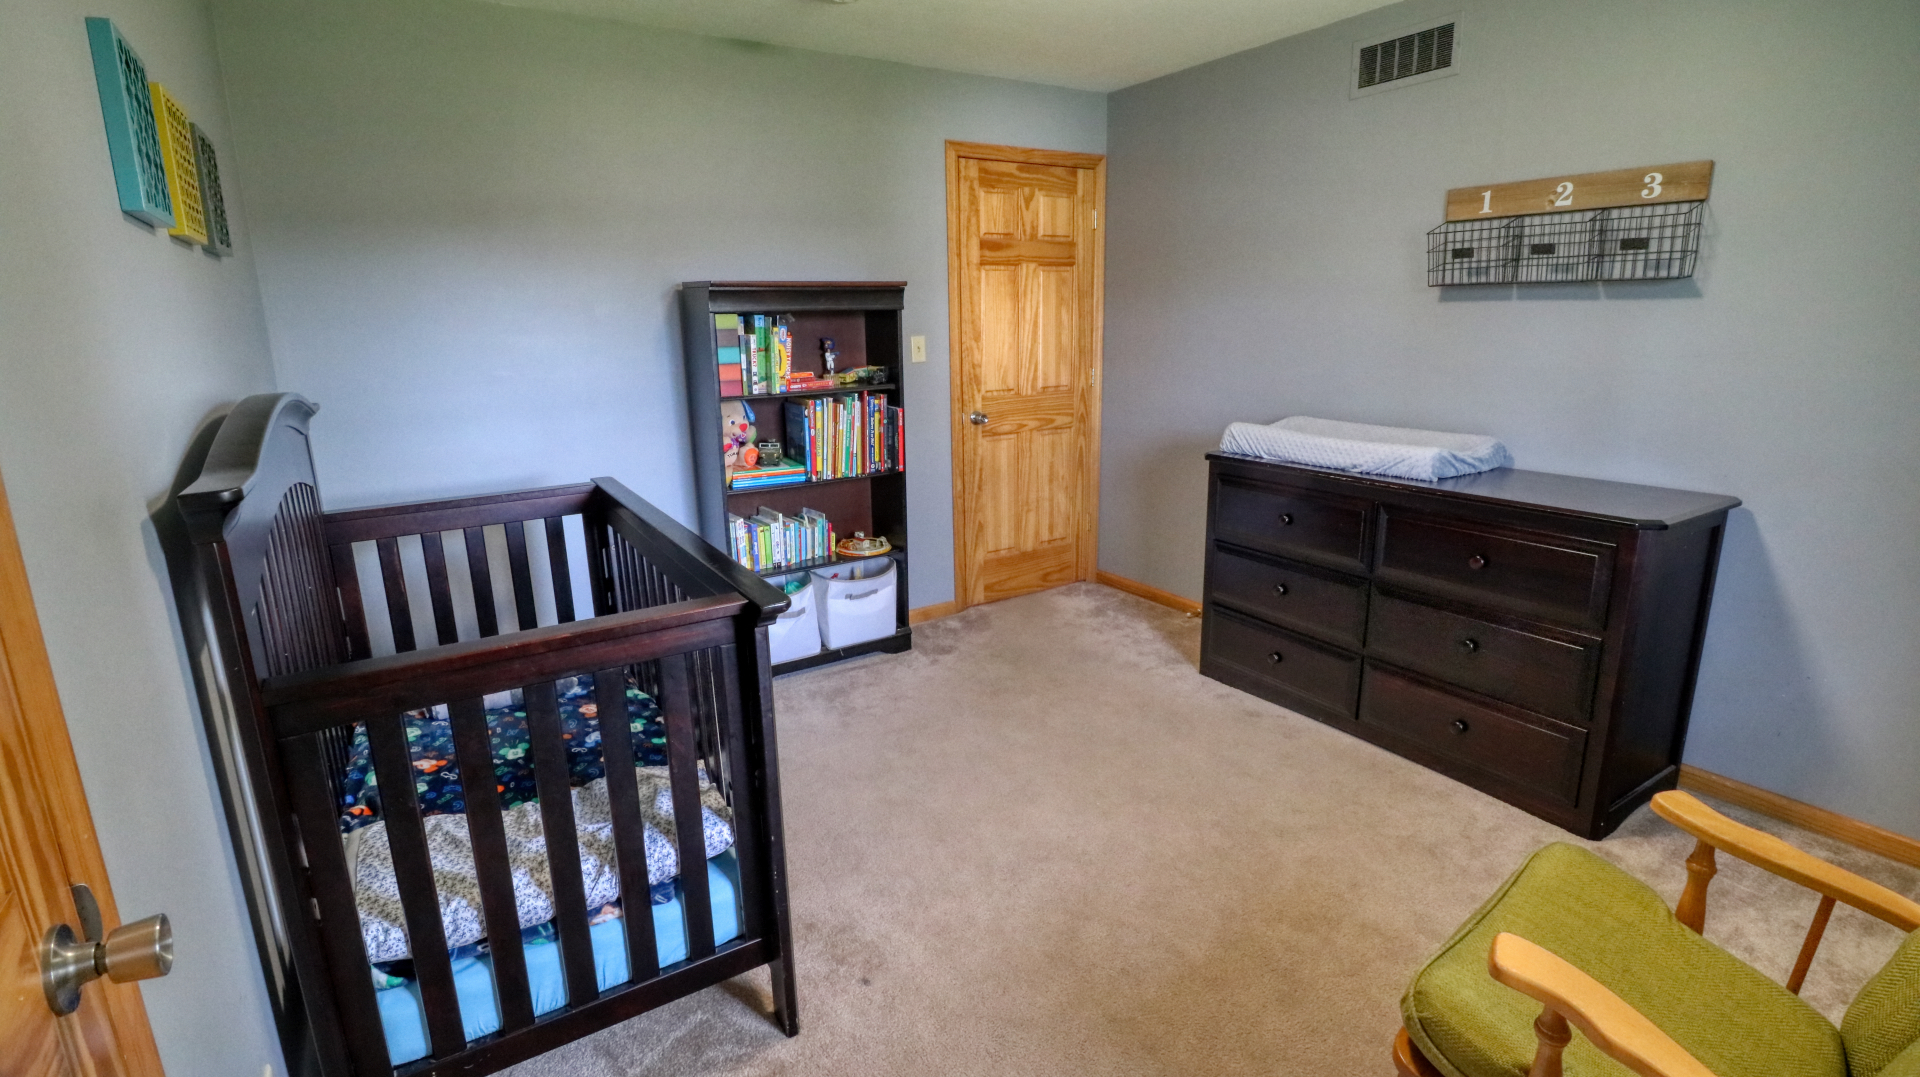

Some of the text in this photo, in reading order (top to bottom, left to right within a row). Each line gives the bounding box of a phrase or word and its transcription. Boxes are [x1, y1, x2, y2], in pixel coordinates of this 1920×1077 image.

[1479, 172, 1663, 214] 1 2 3
